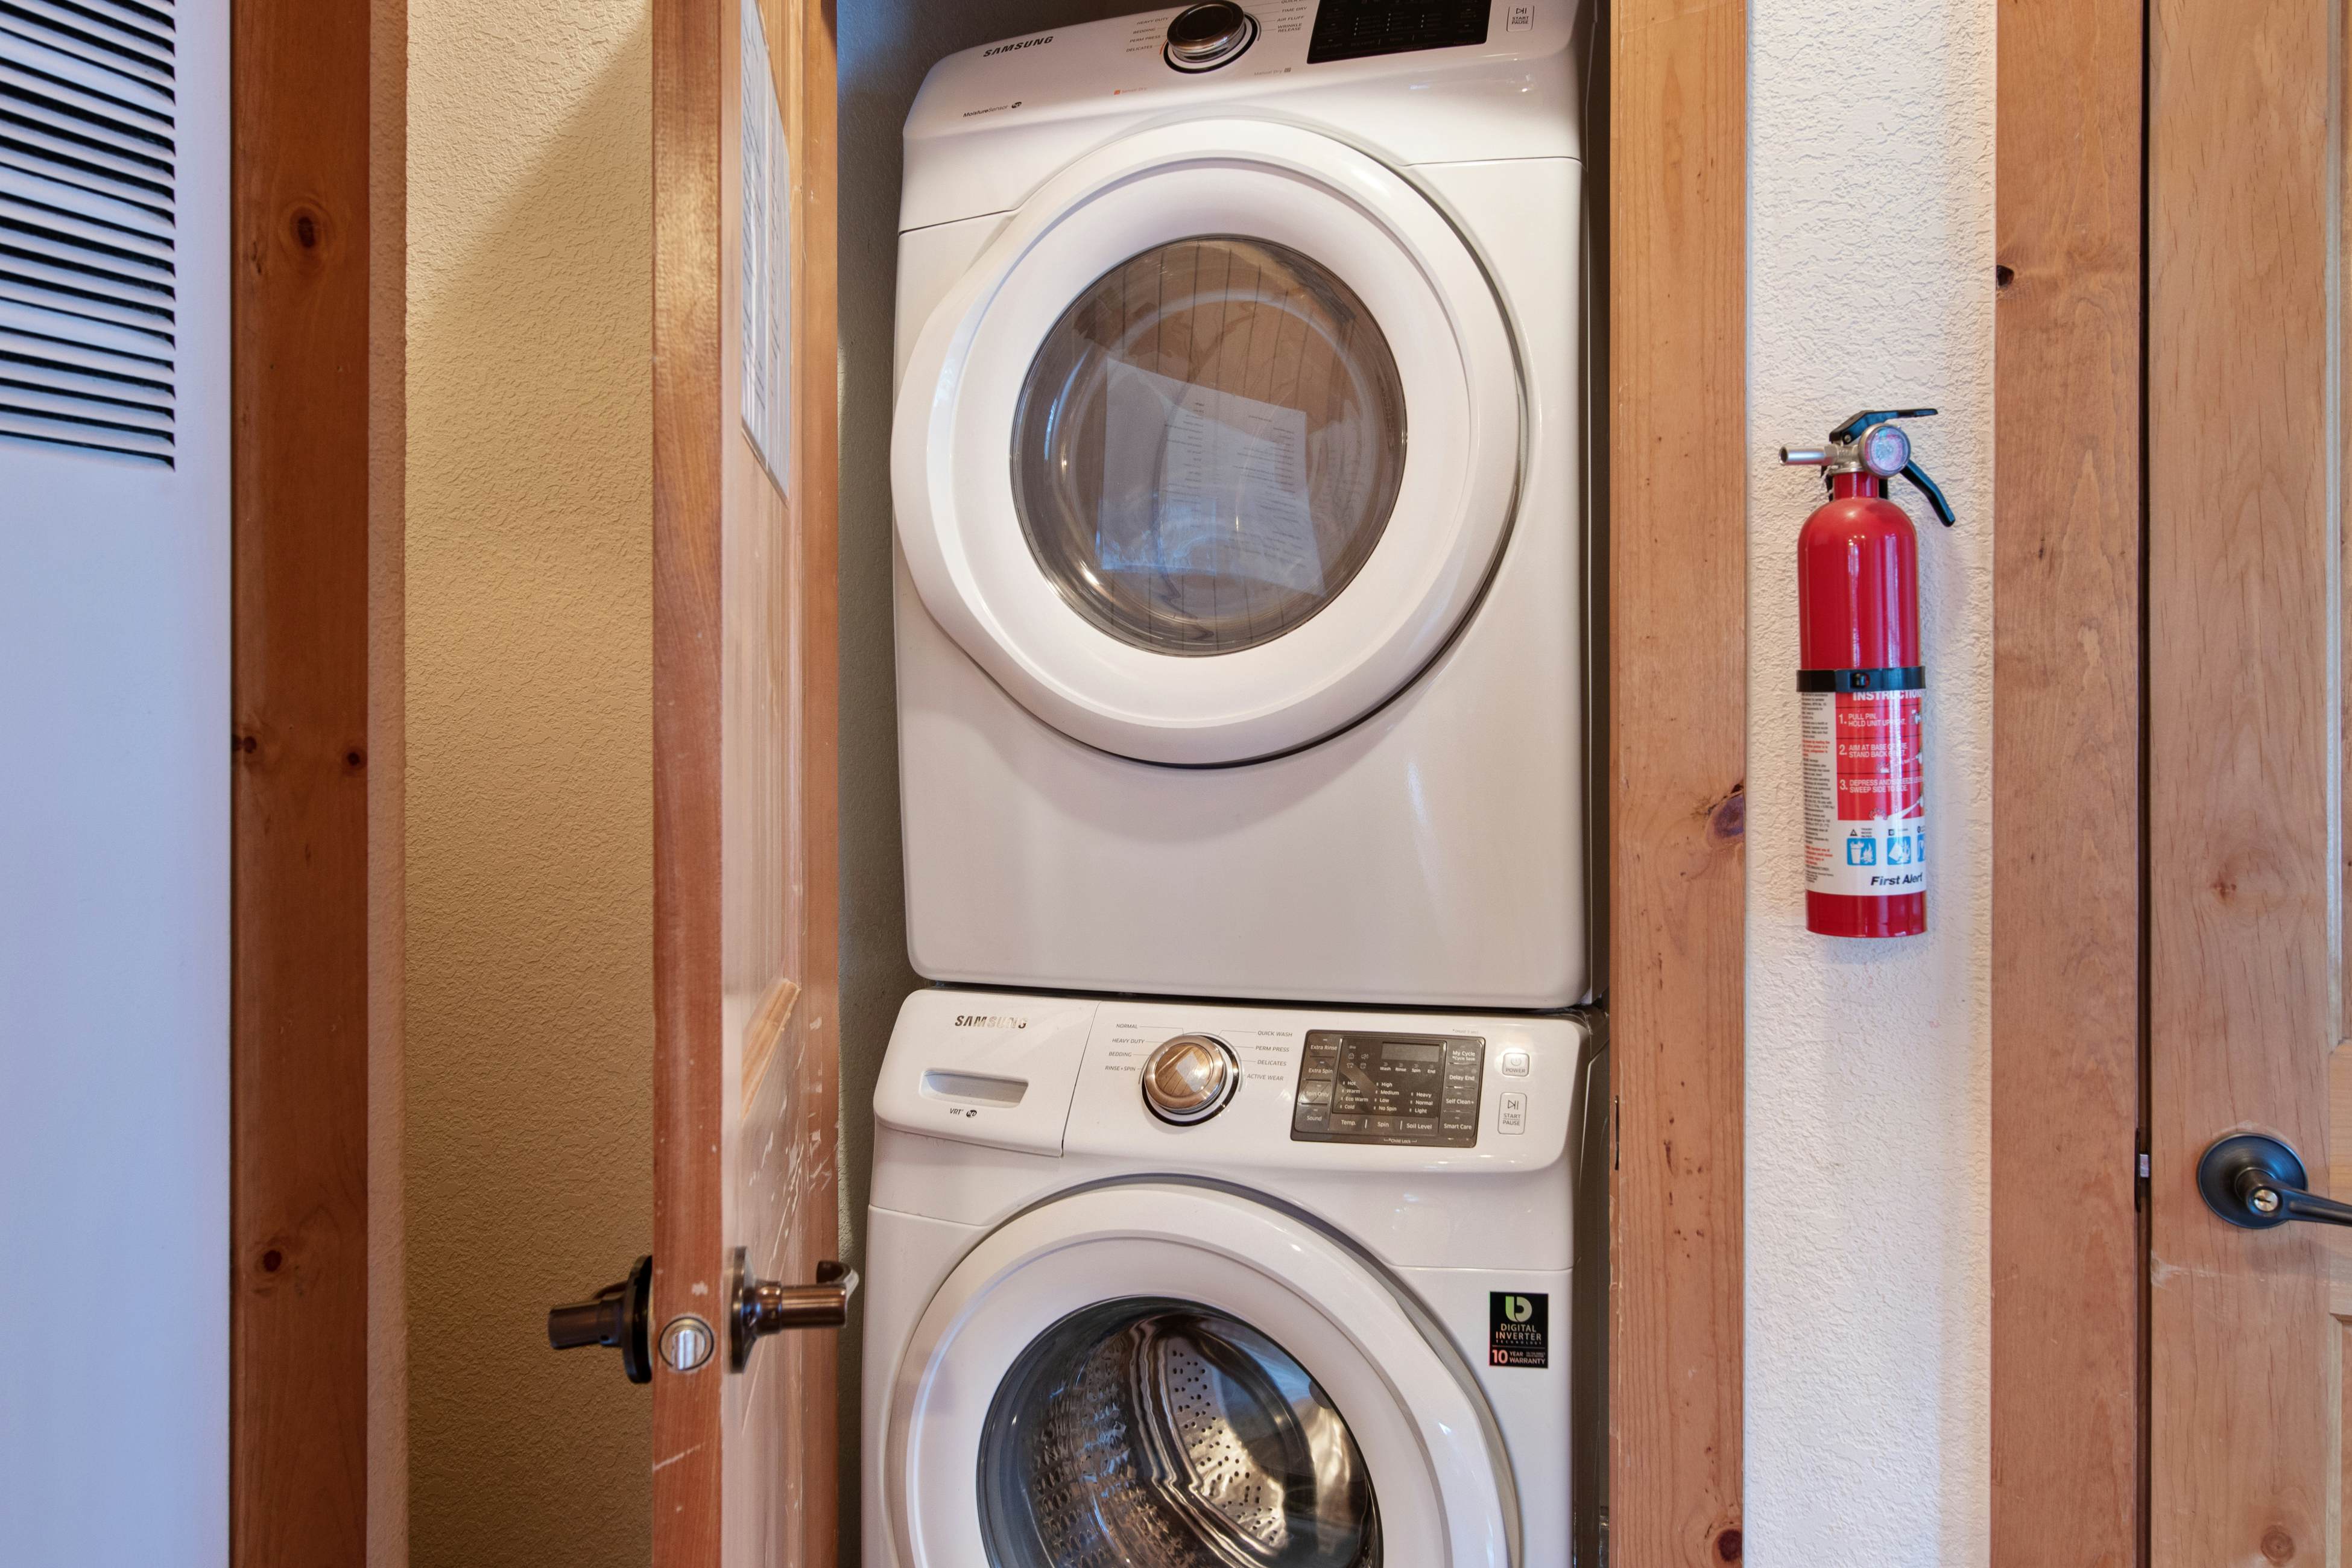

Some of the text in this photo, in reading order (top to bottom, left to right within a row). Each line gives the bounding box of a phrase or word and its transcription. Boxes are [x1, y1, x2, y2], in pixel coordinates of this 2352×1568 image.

[983, 36, 1054, 57] SAMSUNG
[1838, 714, 1847, 724] 1.
[1839, 744, 1847, 755] 2.
[1839, 779, 1848, 790] 3.
[1870, 872, 1923, 885] First Alert
[955, 1015, 1028, 1029] SAMSUNG
[1500, 1323, 1537, 1333] DIGITAL
[1496, 1331, 1541, 1341] INVERTER
[1492, 1349, 1508, 1364] 10
